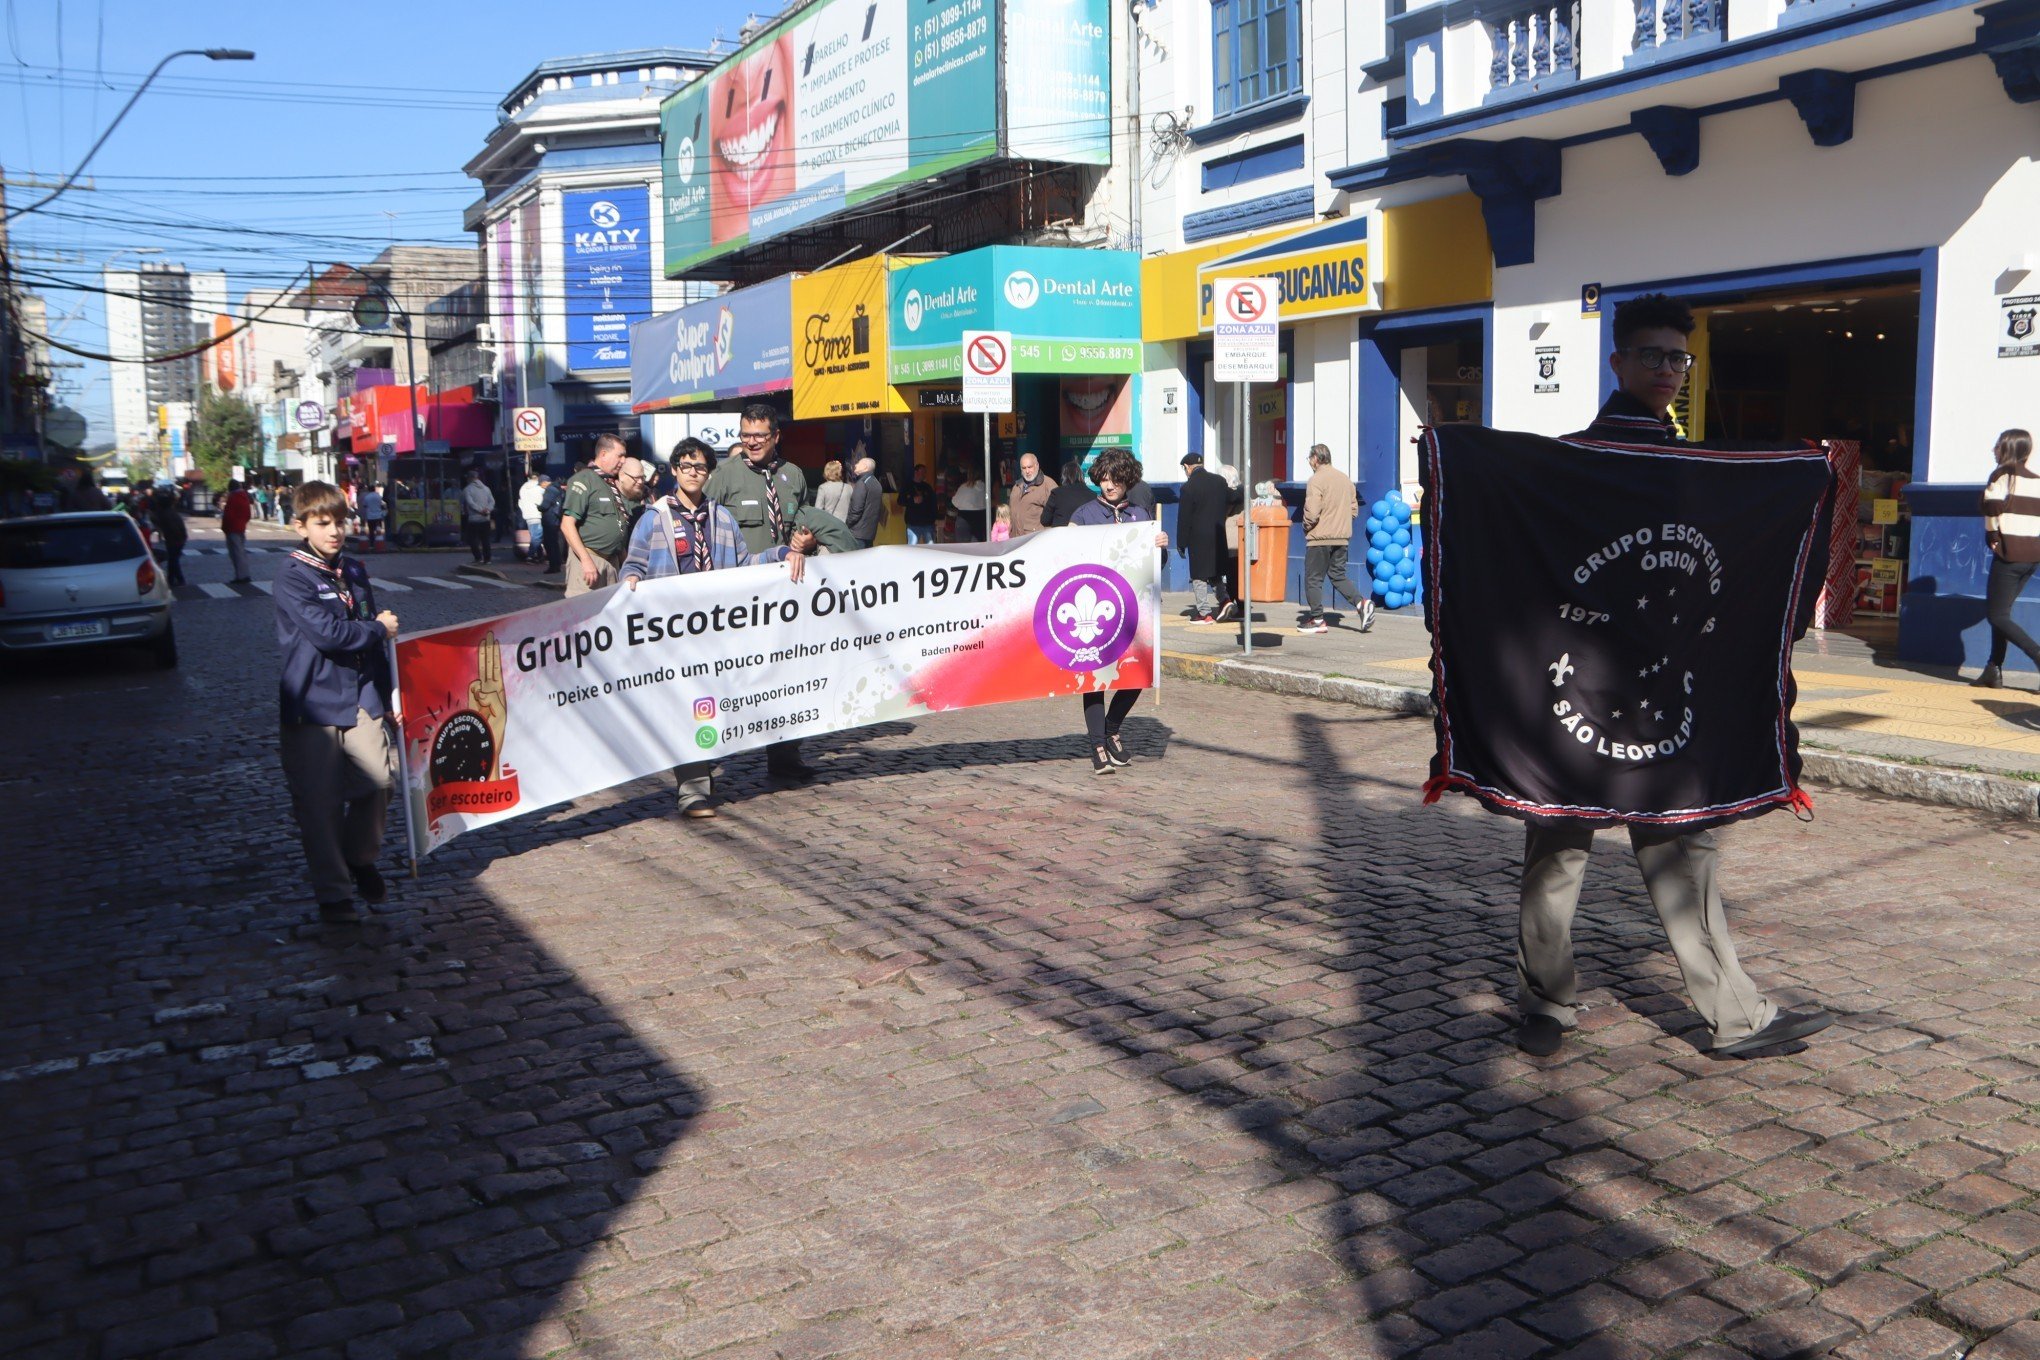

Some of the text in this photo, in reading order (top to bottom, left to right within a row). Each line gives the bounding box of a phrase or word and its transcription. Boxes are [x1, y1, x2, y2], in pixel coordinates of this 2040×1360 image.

[924, 14, 939, 40] (51)
[940, 0, 982, 29] 3099-1144
[1070, 19, 1103, 38] Arte
[924, 15, 987, 64] (51) 99556-8879
[810, 37, 891, 93] IMPLANTE E PRÓTESE
[913, 45, 987, 87] dentalarteclinicas.com.br
[810, 78, 866, 119] CLAREAMENTO
[811, 92, 895, 145] TRATAMENTO CLÍNICO
[811, 119, 901, 170] BOTOX E BICHECTOMIA
[669, 185, 706, 215] Dental Arte
[575, 228, 640, 248] KATY
[924, 284, 978, 311] Dental Arte
[1043, 278, 1133, 297] Dental Arte
[676, 318, 710, 357] Super
[1219, 325, 1274, 334] ZONA AZUL
[669, 349, 715, 389] Compra
[1020, 345, 1134, 360] 545 9556.8879
[966, 377, 1010, 385] ZONA AZUL
[1573, 527, 1653, 584] GRUPO
[1640, 551, 1698, 576] ÓRION
[515, 558, 1027, 674] Grupo Escoteiro Órion 197/RS
[602, 681, 613, 694] o
[616, 665, 676, 692] mundo
[681, 661, 709, 678] um
[714, 651, 764, 682] pouco
[769, 640, 827, 664] melhor
[830, 632, 849, 653] do
[853, 630, 882, 652] que
[886, 629, 896, 642] o
[921, 640, 985, 657] Baden Powell
[718, 677, 829, 715] @grupoorion197
[436, 715, 486, 750] GRUPO ESCOTEIRO
[721, 707, 821, 745] (51) 98189-8633
[1552, 700, 1594, 744] SÃO
[1596, 706, 1693, 761] LEOPOLDO
[451, 788, 513, 806] escoteiro
